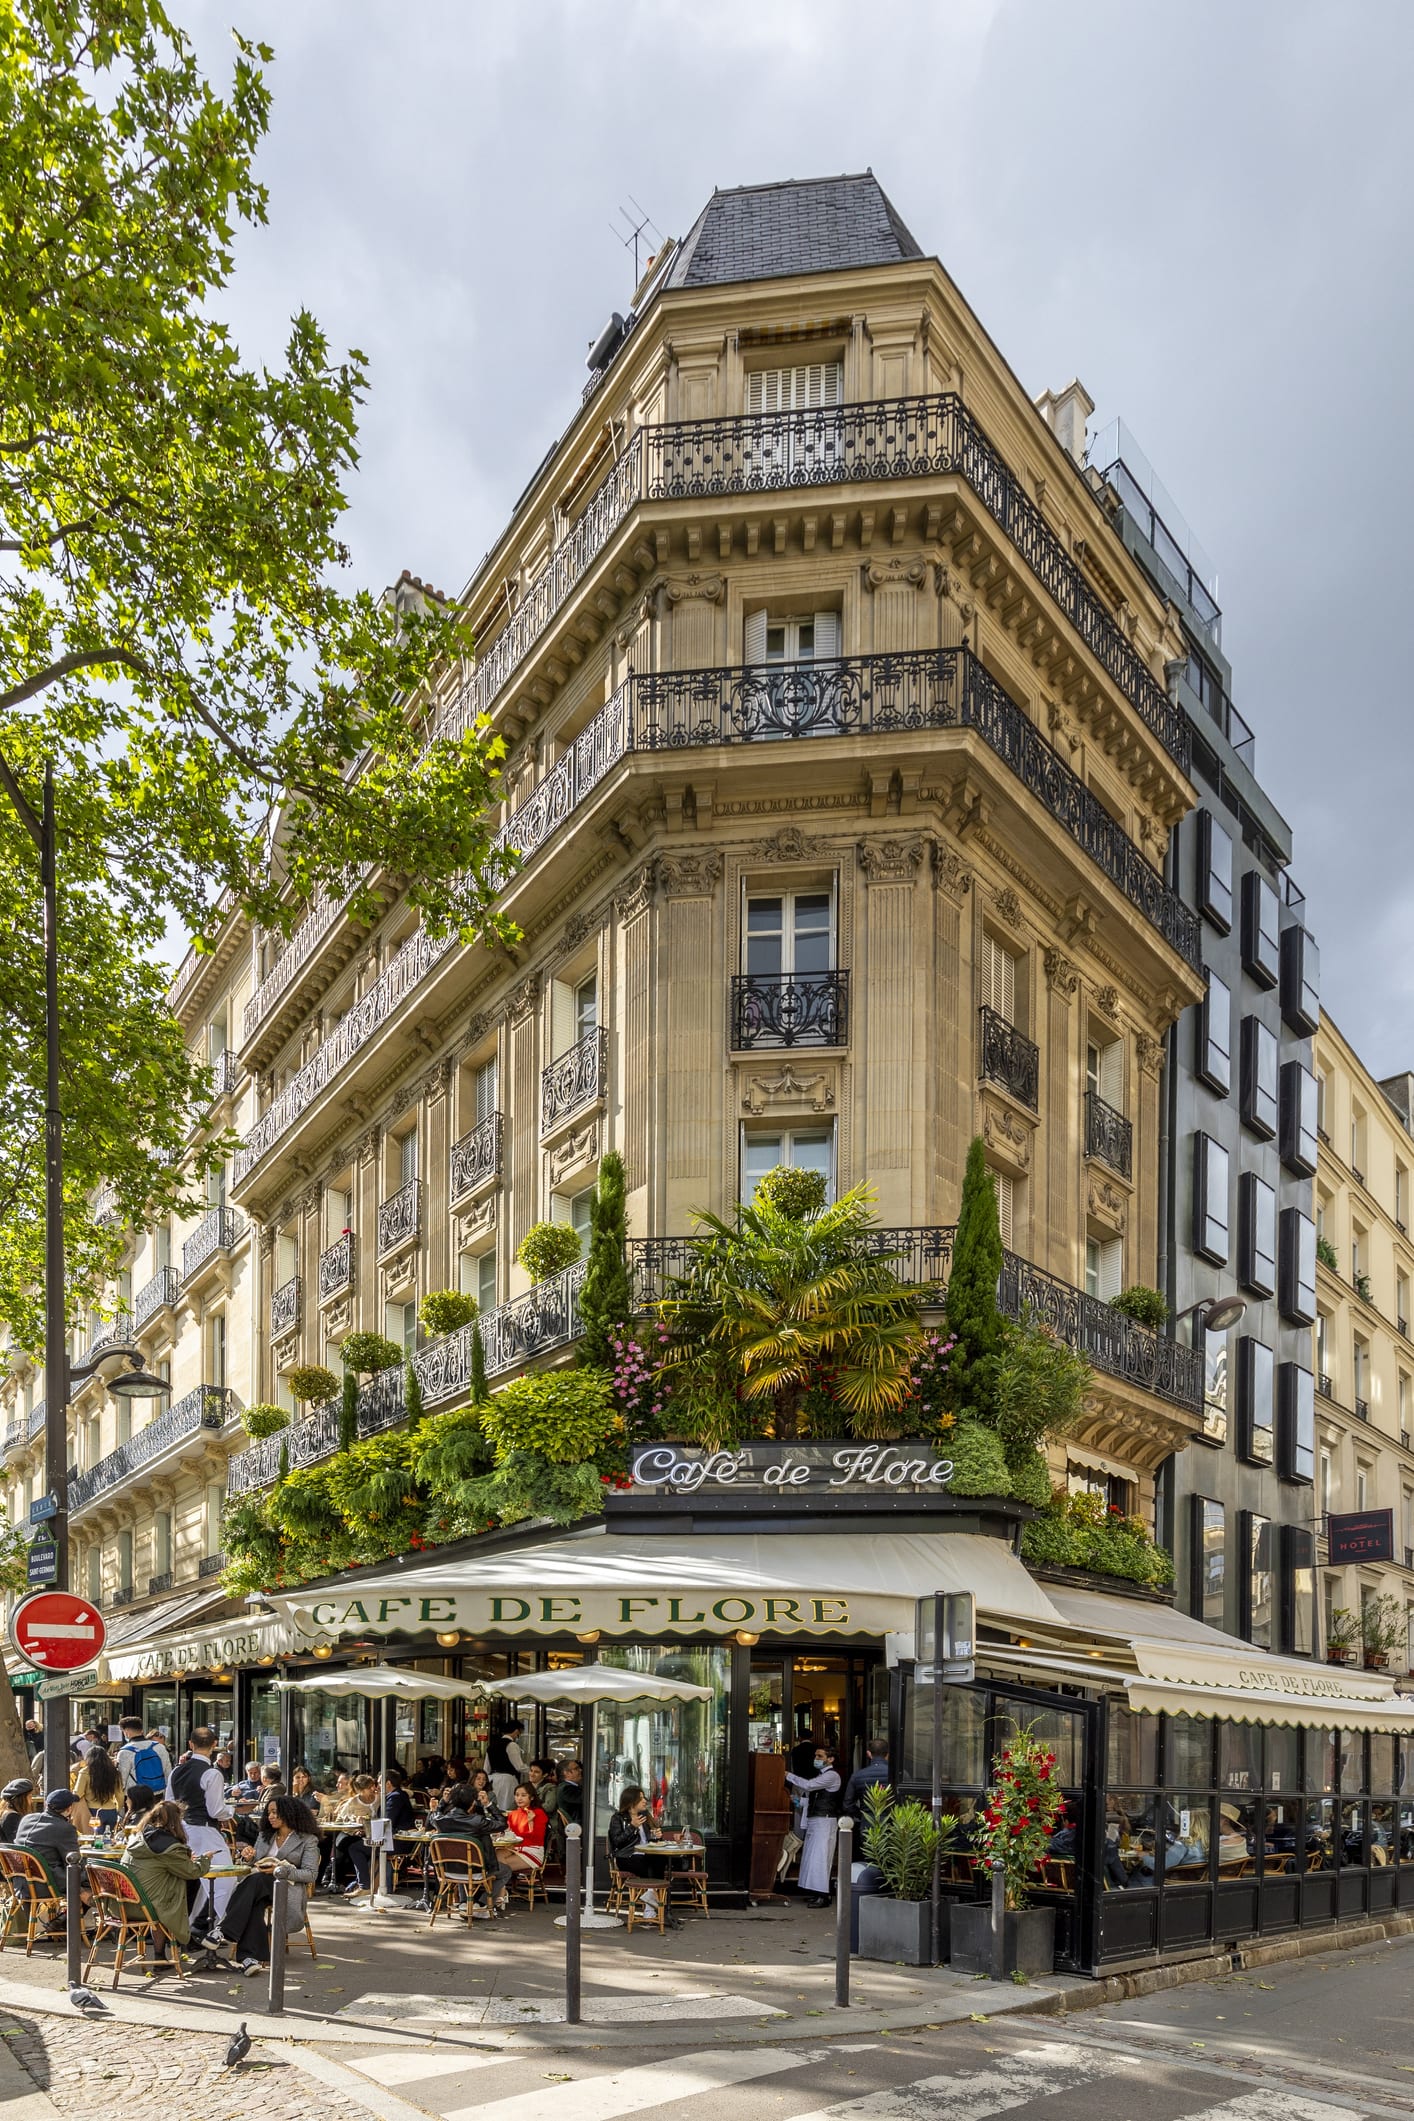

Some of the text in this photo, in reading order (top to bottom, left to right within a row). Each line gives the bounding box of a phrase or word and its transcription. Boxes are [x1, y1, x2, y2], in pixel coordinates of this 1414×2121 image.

[632, 1445, 954, 1494] Café de Flore
[1340, 1539, 1382, 1550] HOTEL
[31, 1552, 54, 1563] BOULEVARD
[312, 1597, 851, 1625] CAFE DE FLORE
[138, 1634, 259, 1670] CAFE DE FLORE
[1239, 1670, 1343, 1693] CAFE DE FLORE
